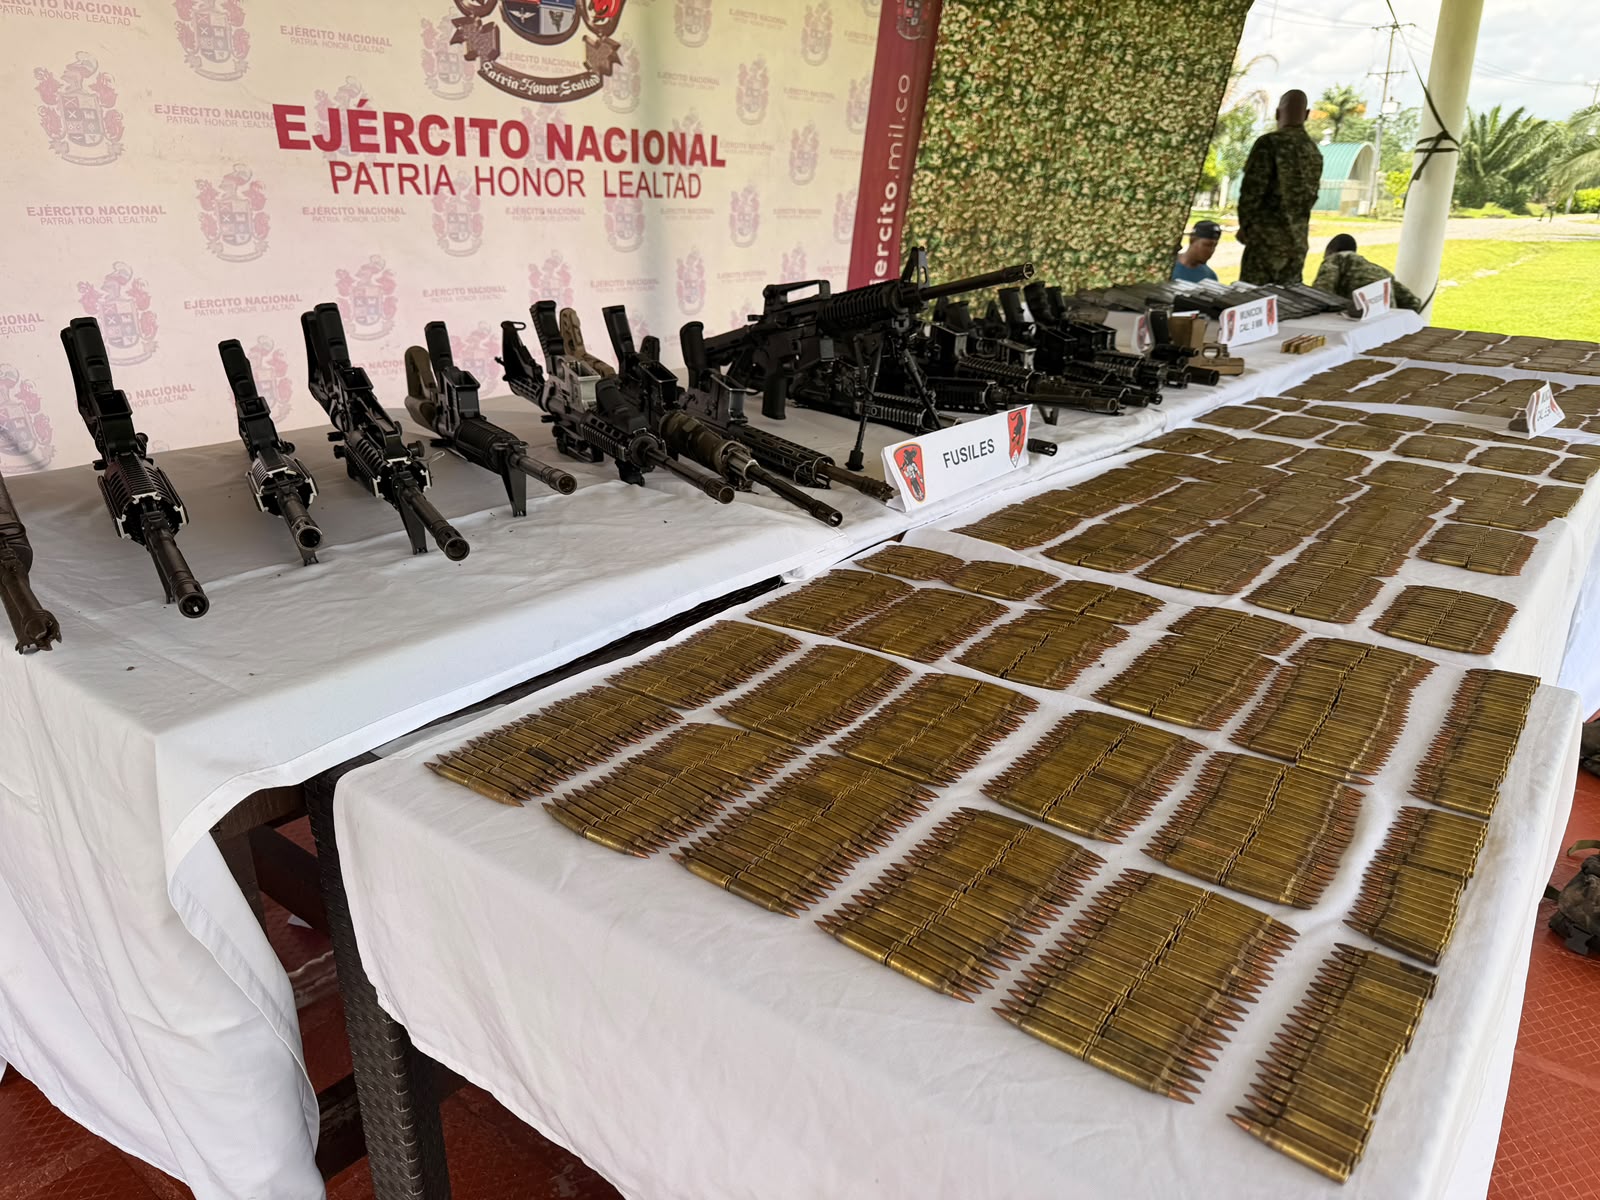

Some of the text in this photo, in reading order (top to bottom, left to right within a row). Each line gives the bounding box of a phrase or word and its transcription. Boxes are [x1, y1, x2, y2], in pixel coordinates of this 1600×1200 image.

[1, 0, 142, 18] RCITO NACIONAL
[39, 8, 80, 21] HONOR
[86, 14, 131, 26] LEALTAD
[338, 31, 392, 47] NACIONAL
[519, 78, 559, 95] Honor
[154, 103, 275, 122] EJÉRCITO NACIONA
[166, 115, 200, 125] PATRIA
[204, 119, 239, 128] HONOR
[272, 99, 727, 169] EJÉRCITO NACIONAL
[329, 160, 702, 200] PATRIA HONOR LEALTAD
[26, 204, 167, 217] EJÉRCITO NACIONAL
[357, 206, 407, 216] NACIONAL
[40, 215, 158, 226] PATRIA HONOR LEALTAD
[244, 293, 303, 305] NACIONAL
[0, 312, 45, 326] IONAL
[0, 323, 36, 336] EALTAD
[135, 383, 197, 400] NACIONAL
[131, 400, 150, 409] NOR
[942, 438, 996, 469] FUSILES
